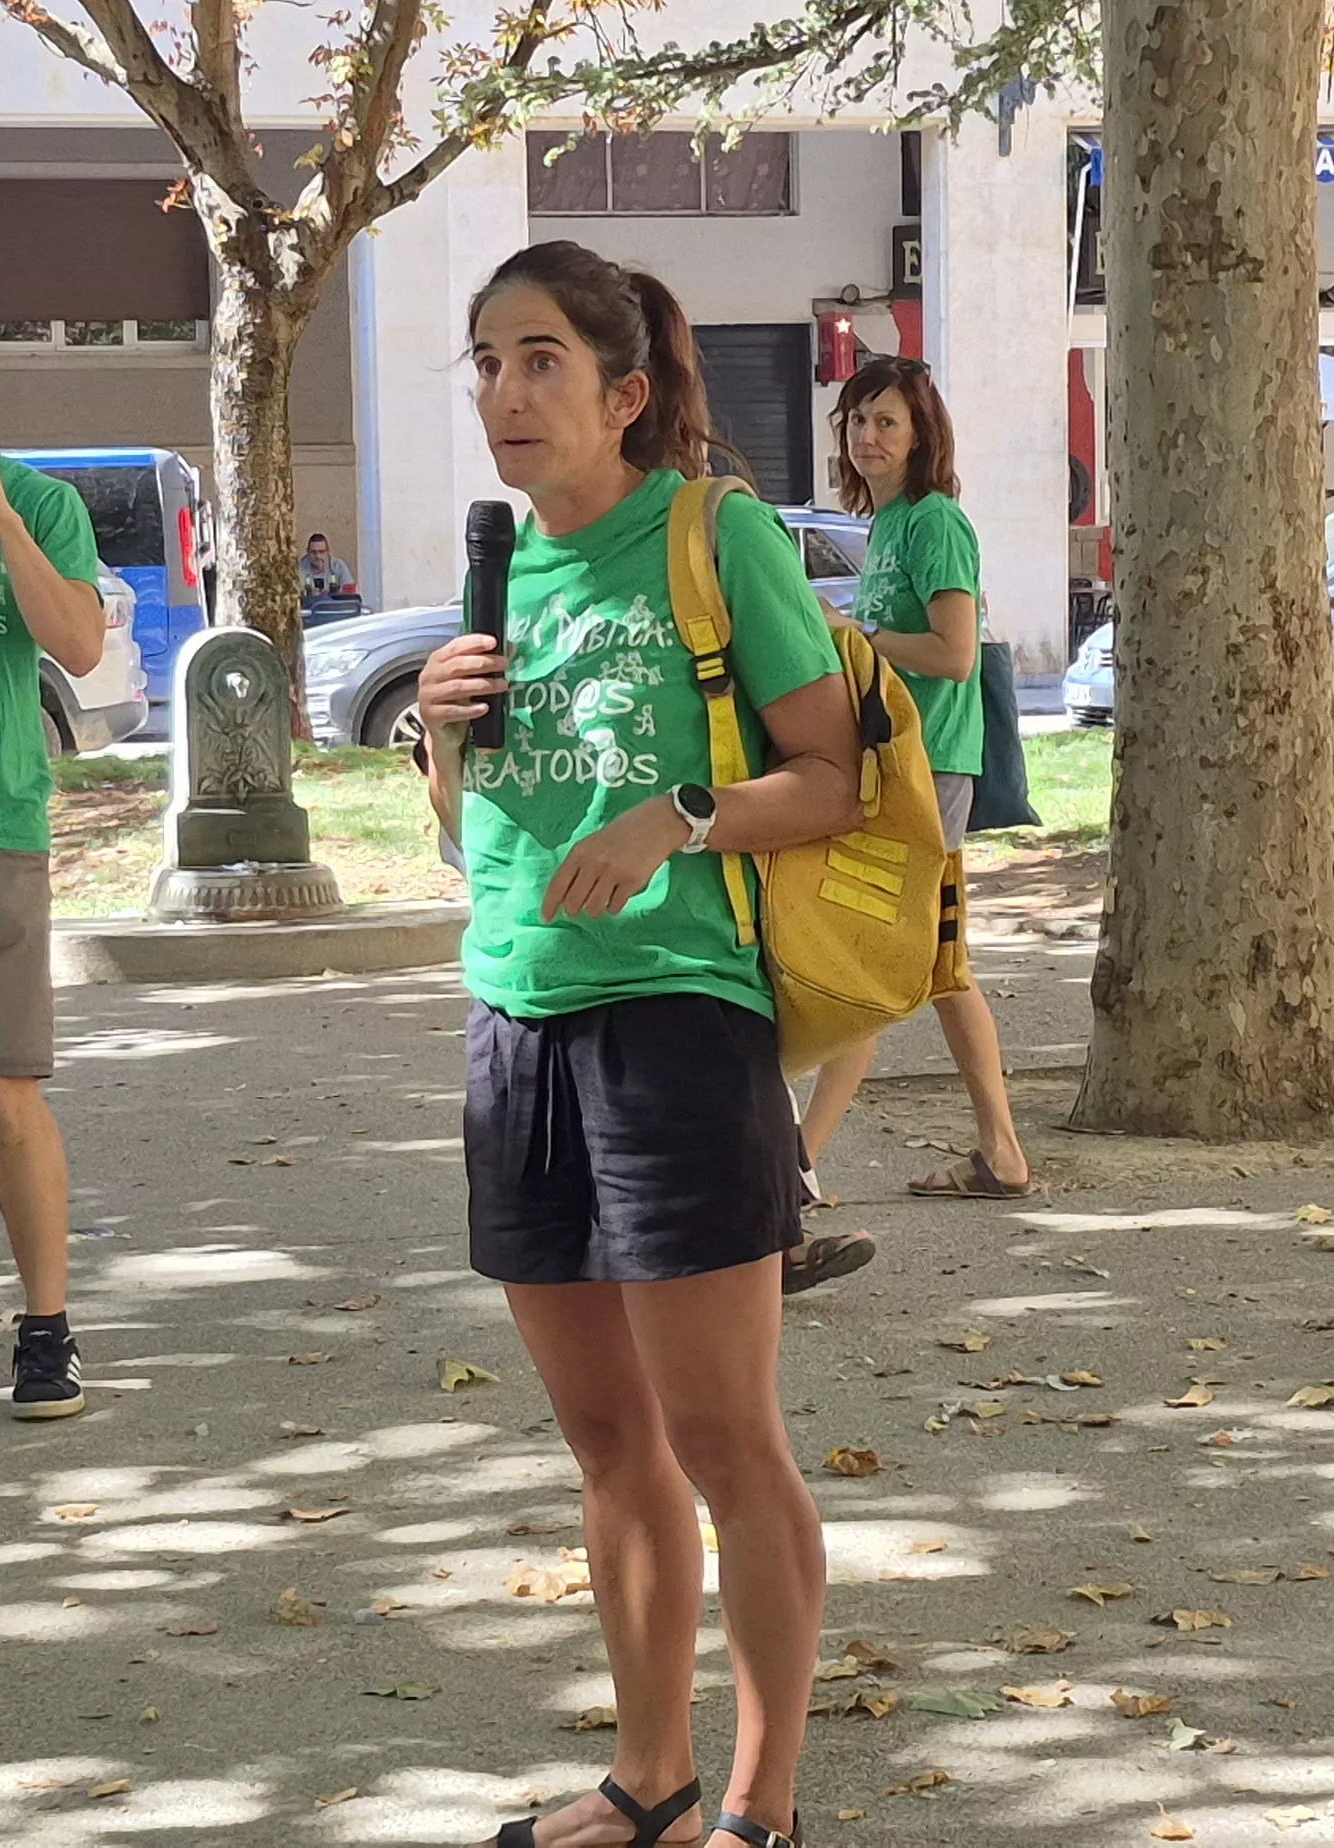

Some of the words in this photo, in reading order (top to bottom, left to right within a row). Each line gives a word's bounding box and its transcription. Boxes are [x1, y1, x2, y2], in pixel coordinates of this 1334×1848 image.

[509, 677, 635, 722] TOD@S
[463, 751, 520, 790] ARA
[529, 747, 659, 788] TOD@S
